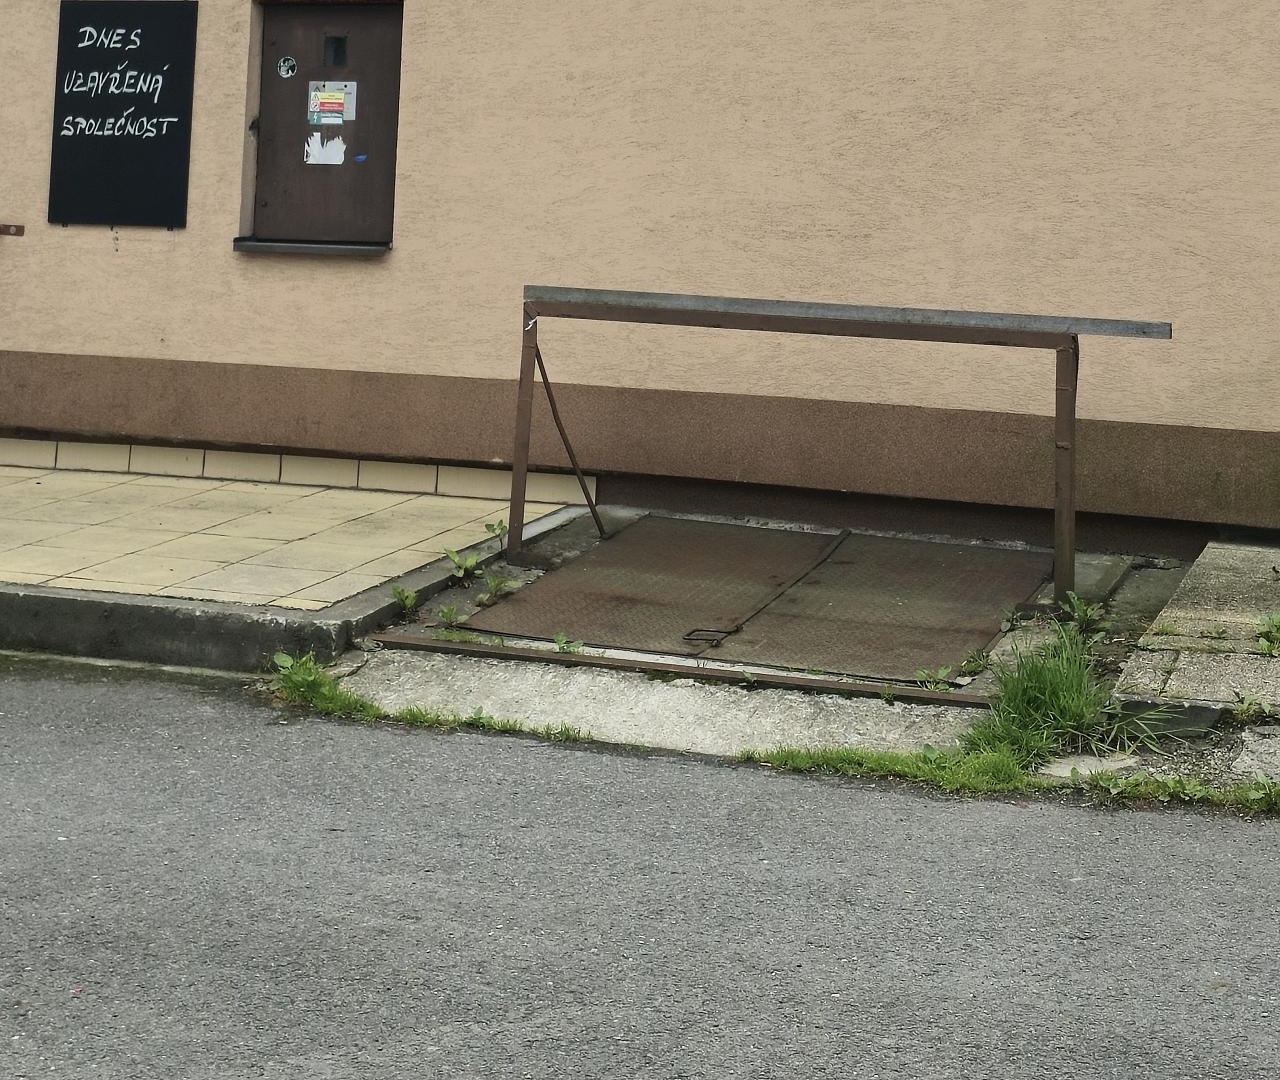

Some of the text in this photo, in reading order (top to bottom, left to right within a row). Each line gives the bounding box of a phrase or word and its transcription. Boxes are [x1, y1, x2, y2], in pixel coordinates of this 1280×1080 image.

[77, 26, 142, 51] DNES
[64, 60, 171, 104] UZAVŘENÁ
[60, 106, 179, 139] SPOLEČNOST
